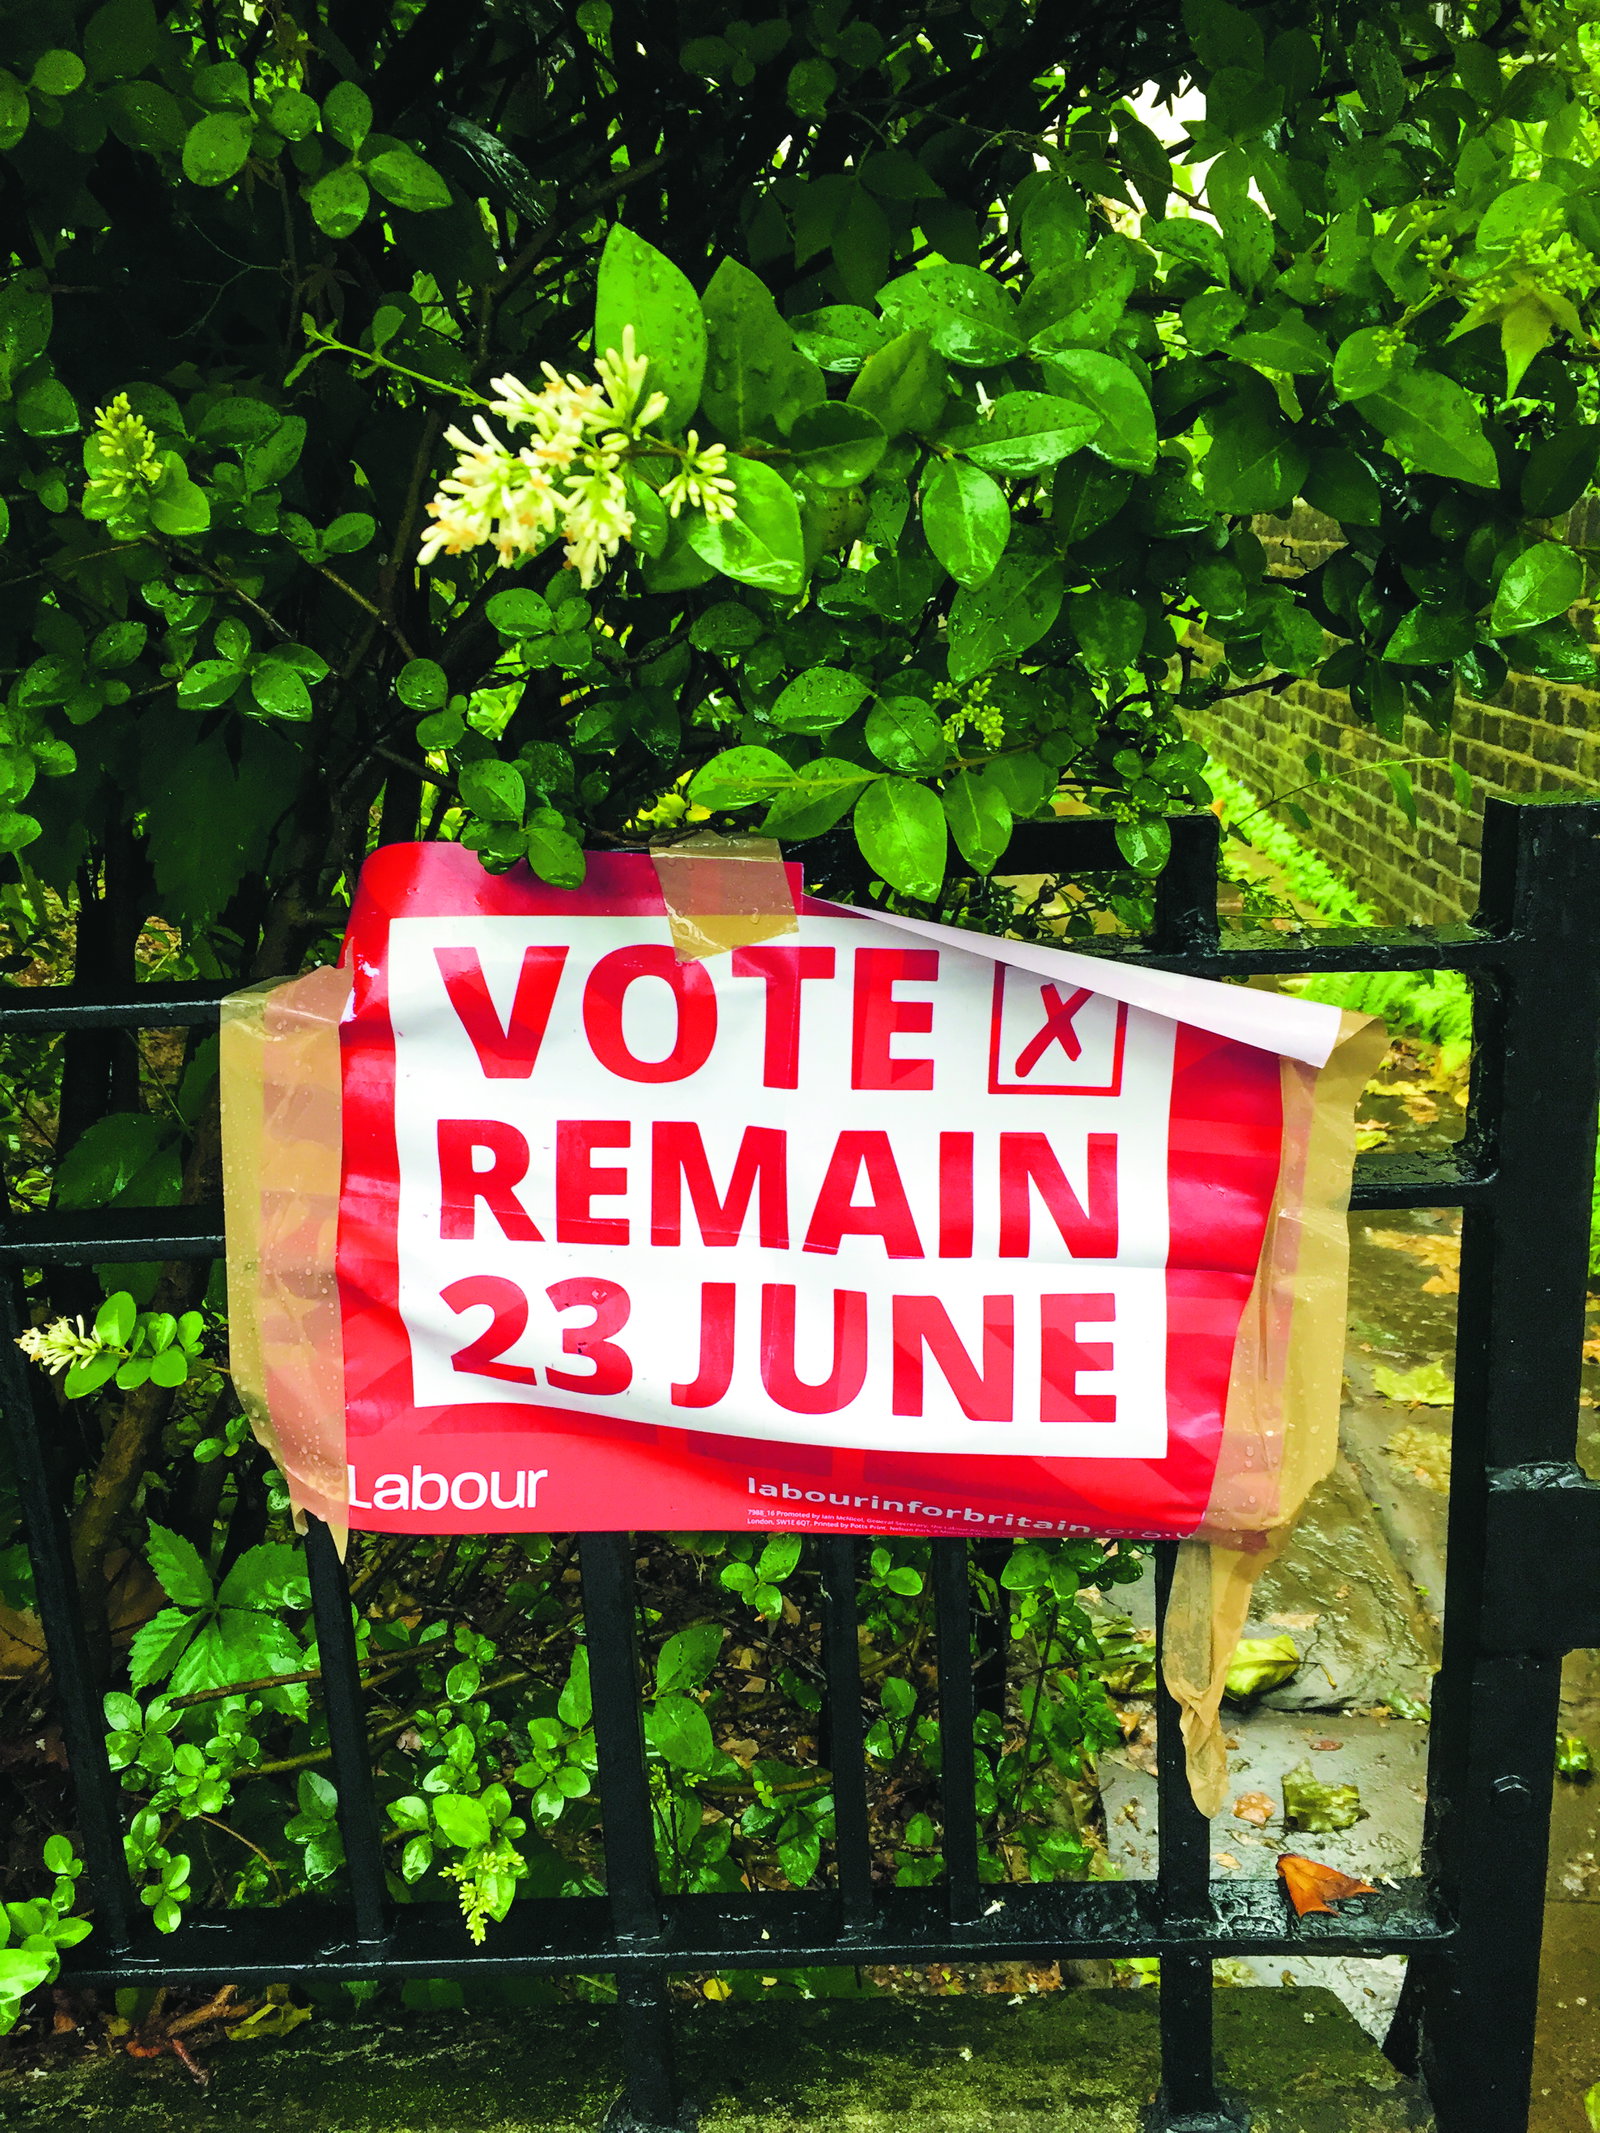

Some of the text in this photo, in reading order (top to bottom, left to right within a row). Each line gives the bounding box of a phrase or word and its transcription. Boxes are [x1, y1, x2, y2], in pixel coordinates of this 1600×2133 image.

[433, 944, 940, 1092] VOTE
[437, 1118, 1118, 1260] REMAIN
[439, 1275, 1117, 1424] 23 JUNE
[346, 1464, 549, 1511] Labour
[776, 1510, 810, 1518] Promoted
